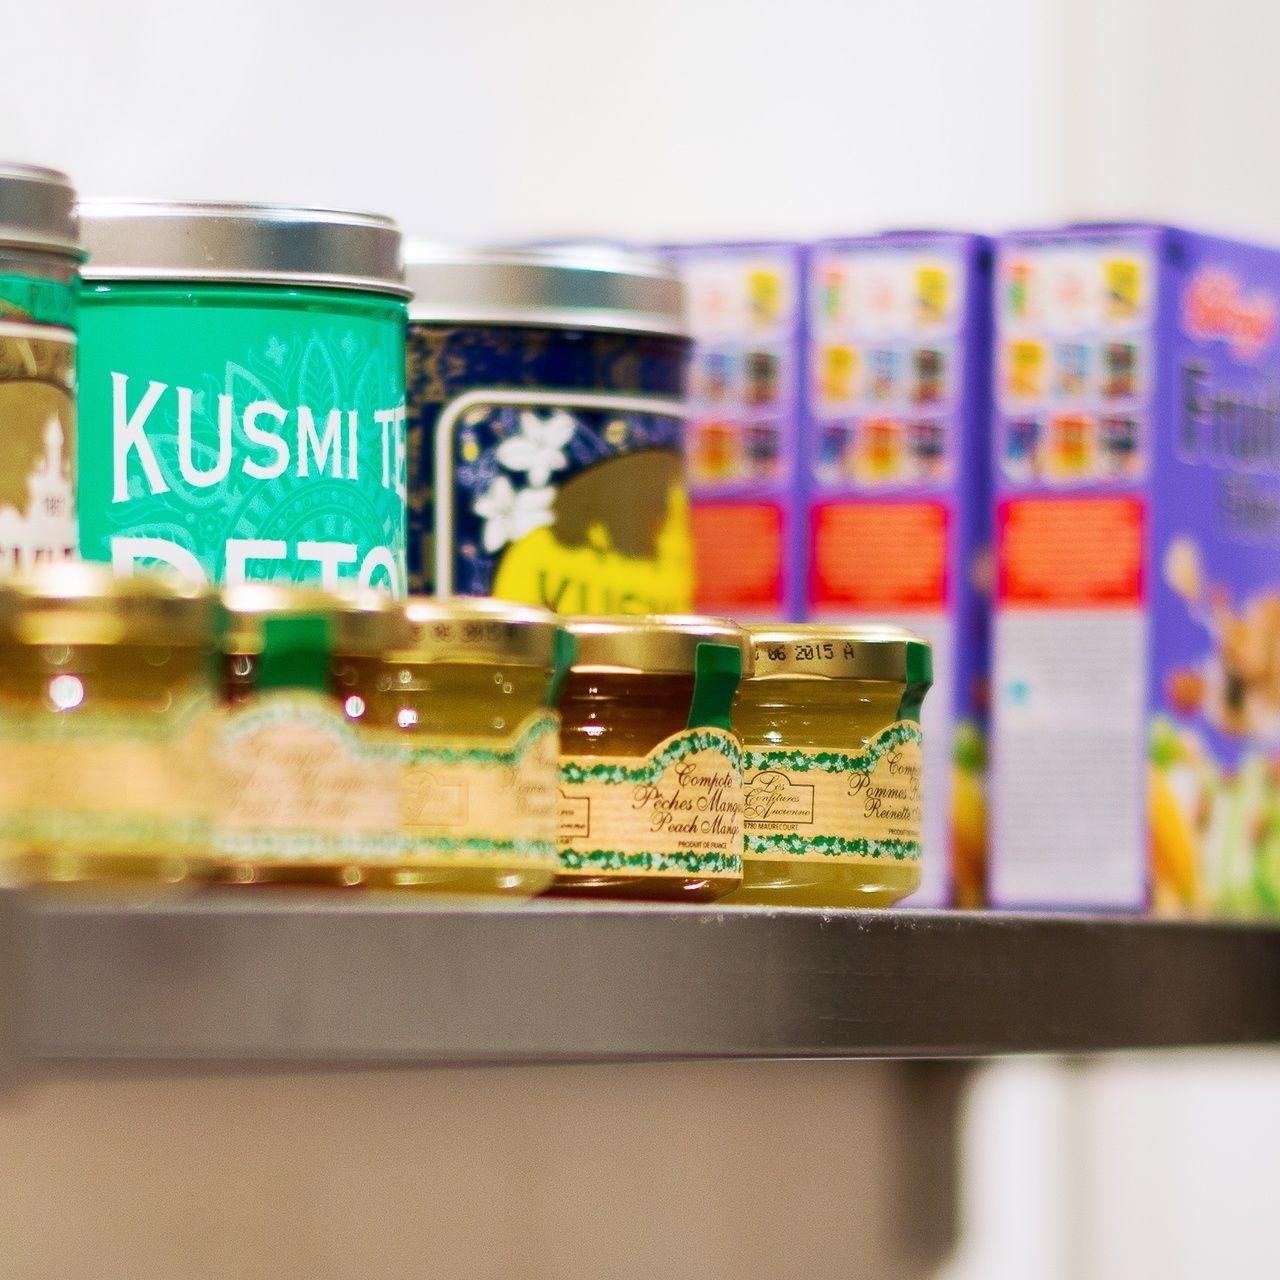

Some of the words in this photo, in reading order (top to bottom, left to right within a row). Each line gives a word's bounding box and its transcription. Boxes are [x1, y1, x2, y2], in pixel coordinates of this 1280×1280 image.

[111, 370, 360, 504] KUSMI
[795, 643, 834, 660] 2015
[675, 761, 733, 796] Compote
[650, 811, 699, 834] Peach
